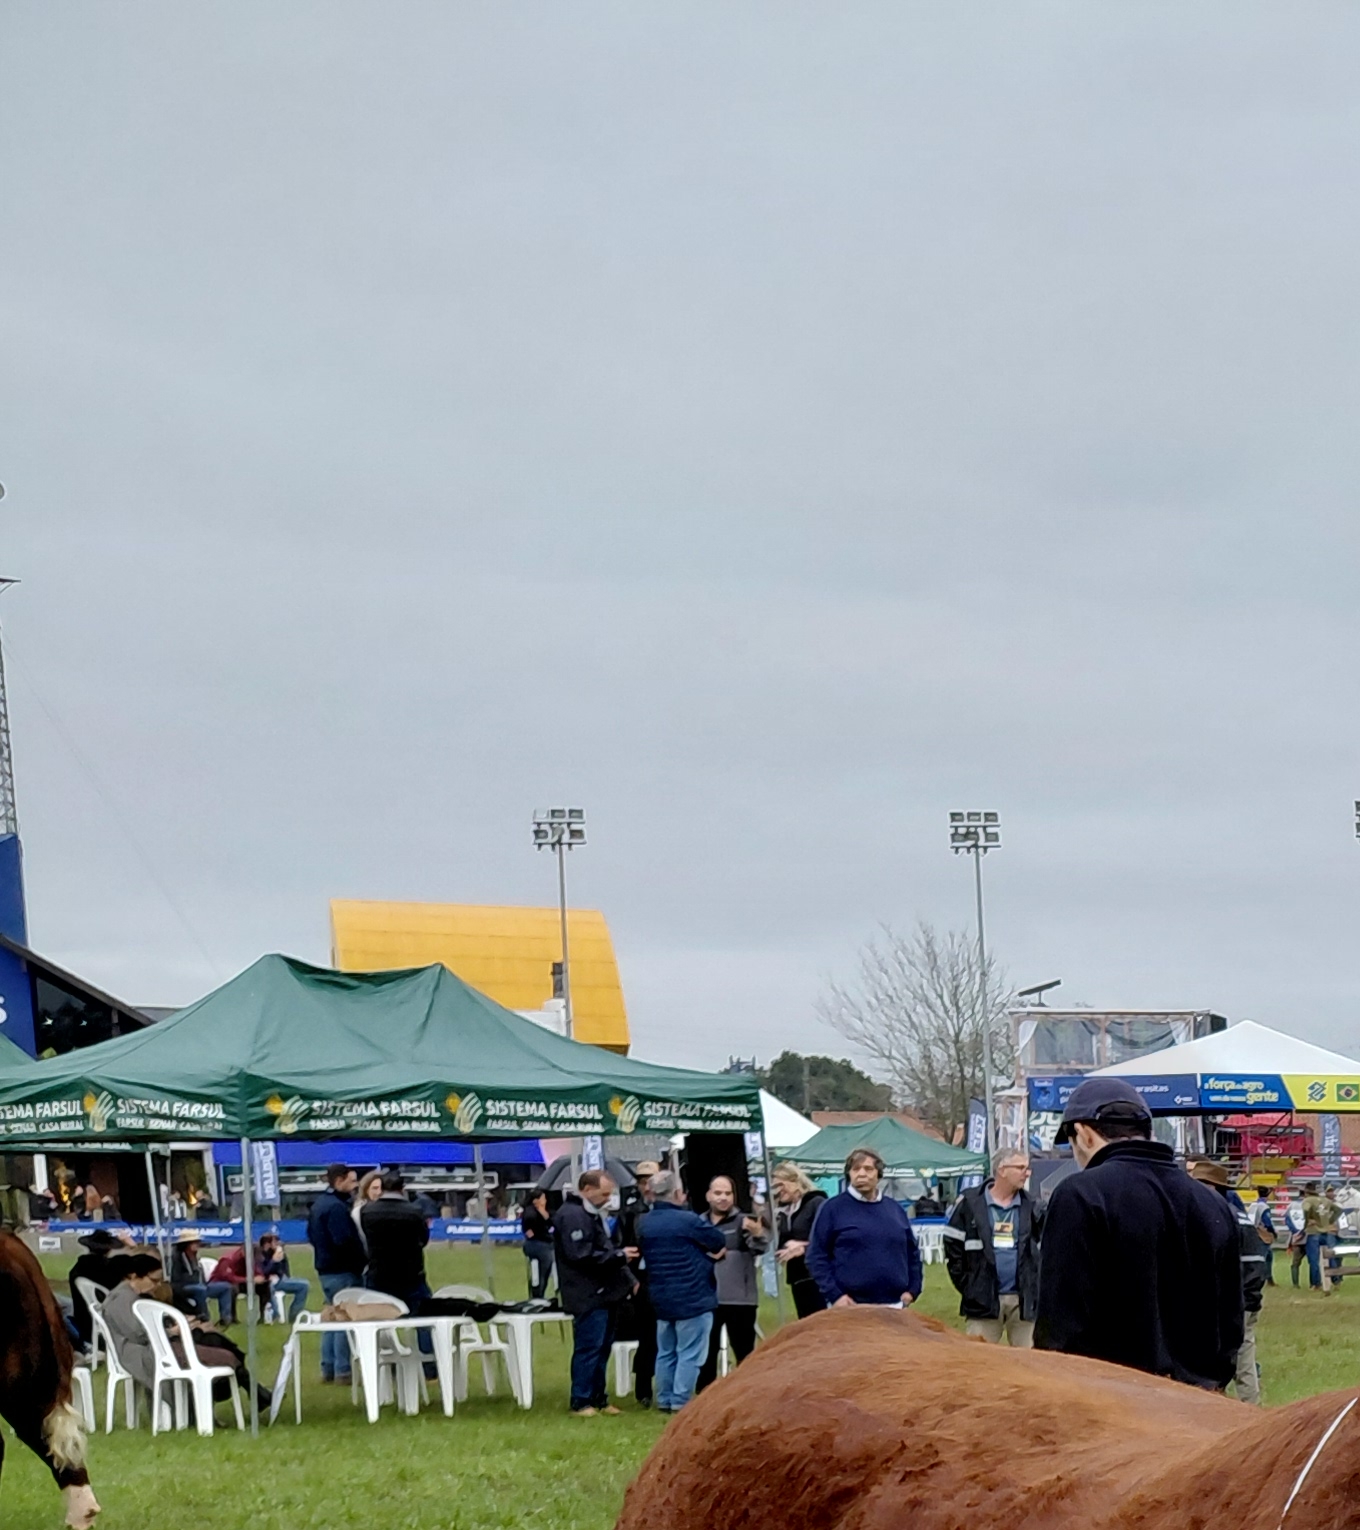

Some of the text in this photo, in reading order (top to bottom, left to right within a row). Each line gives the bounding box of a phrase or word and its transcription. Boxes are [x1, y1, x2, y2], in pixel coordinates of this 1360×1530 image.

[1245, 1090, 1279, 1106] gente
[35, 1099, 84, 1117] FARSUL
[117, 1099, 227, 1119] SISTEMA FARSUL
[310, 1099, 441, 1118] SISTEMA FARSUL
[485, 1099, 604, 1120] SISTEMA FARSUL
[643, 1101, 702, 1118] SISTEMA
